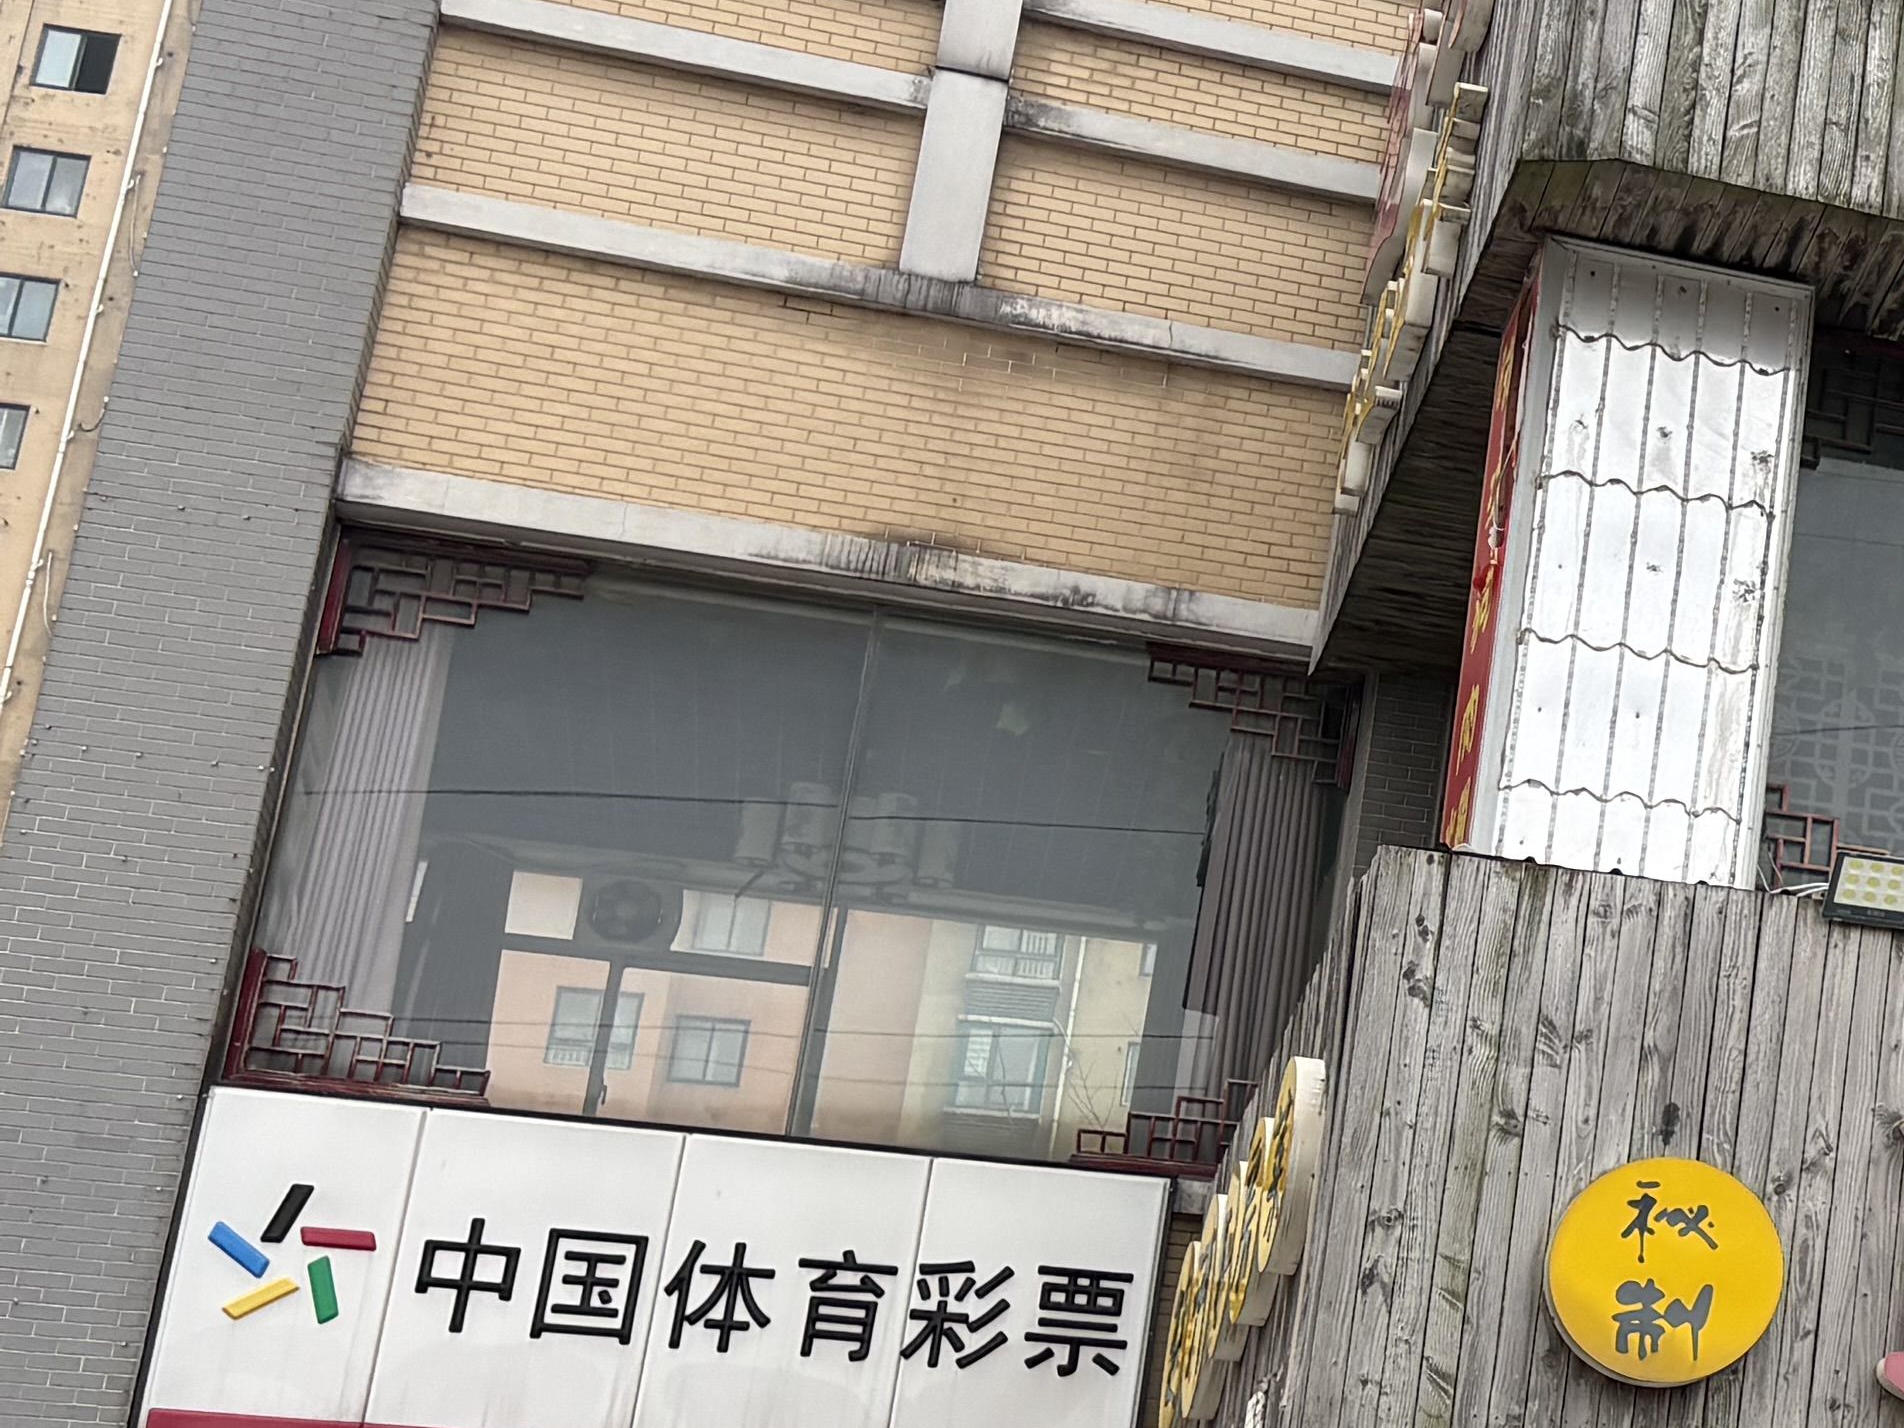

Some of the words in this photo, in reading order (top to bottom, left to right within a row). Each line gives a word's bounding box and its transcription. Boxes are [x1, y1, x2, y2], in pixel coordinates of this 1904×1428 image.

[414, 1216, 1134, 1378] 中国体育彩票
